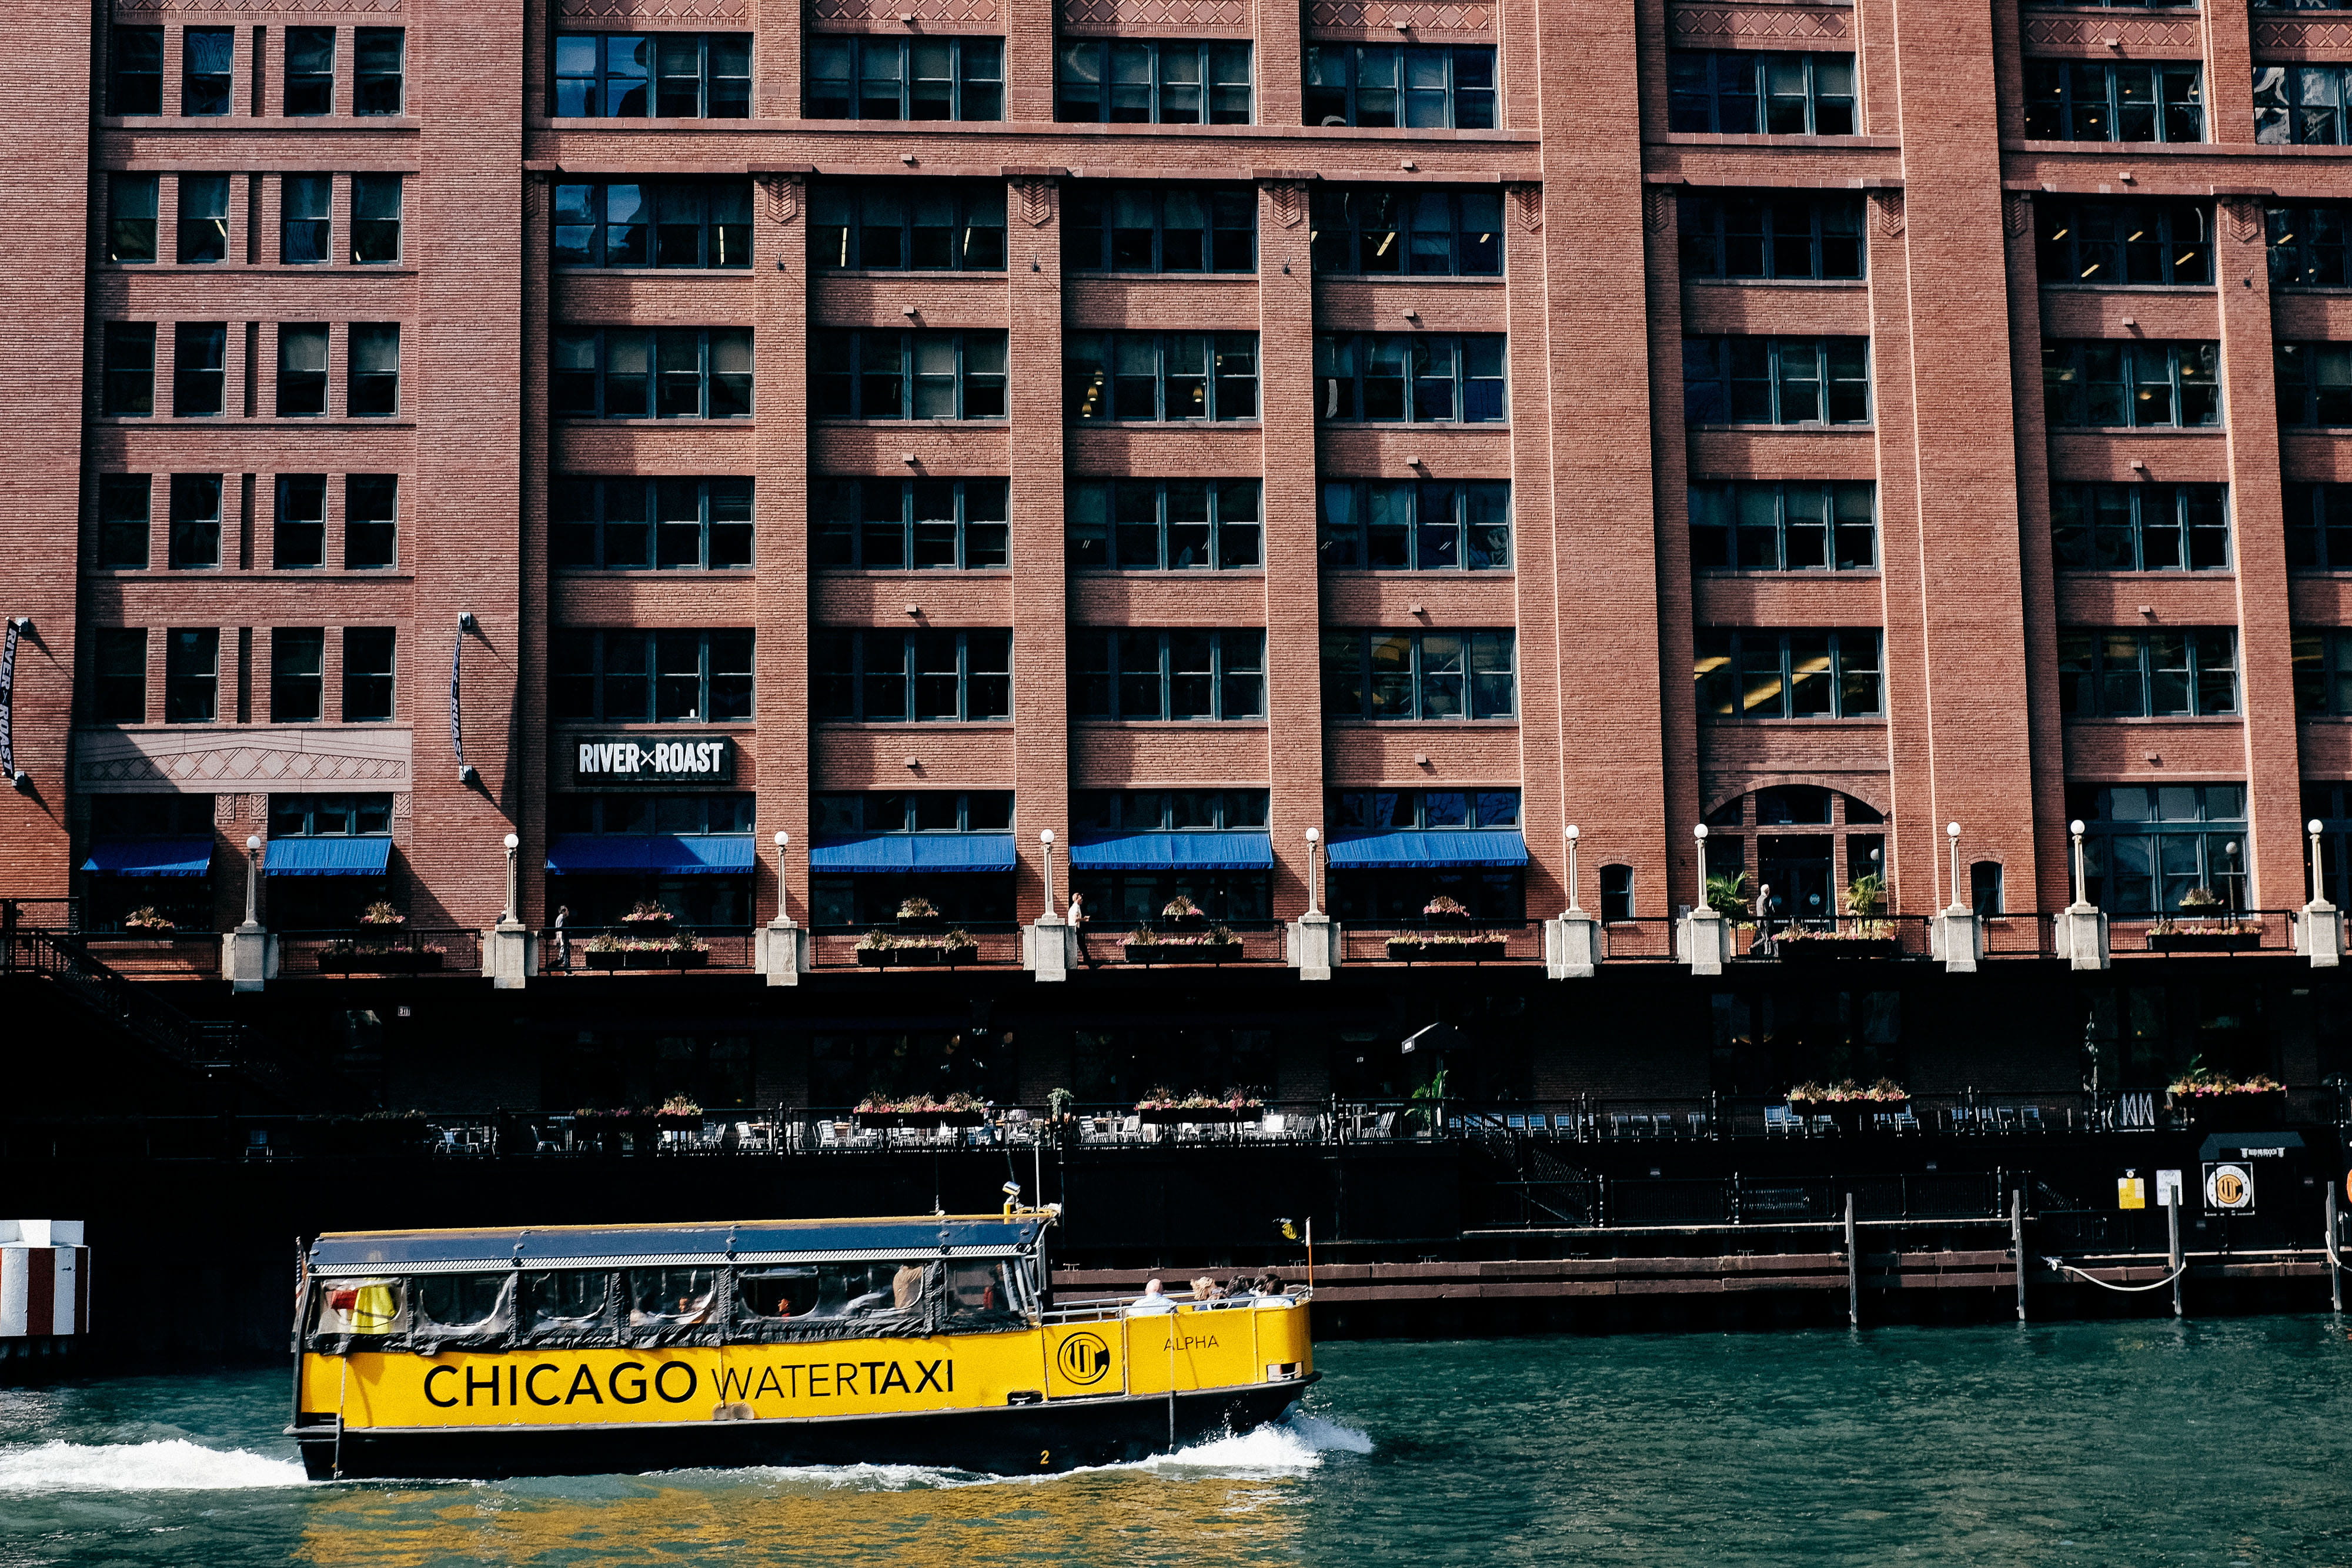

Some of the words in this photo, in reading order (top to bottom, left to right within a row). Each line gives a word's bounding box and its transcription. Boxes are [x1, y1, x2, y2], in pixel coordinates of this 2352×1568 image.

[1, 628, 16, 690] RIVER
[0, 704, 12, 774] ROAST
[579, 743, 640, 773] RIVER
[655, 743, 723, 773] ROAST
[1163, 1335, 1220, 1352] ALPHA
[424, 1360, 697, 1407] CHICAGO
[1040, 1450, 1050, 1465] 2
